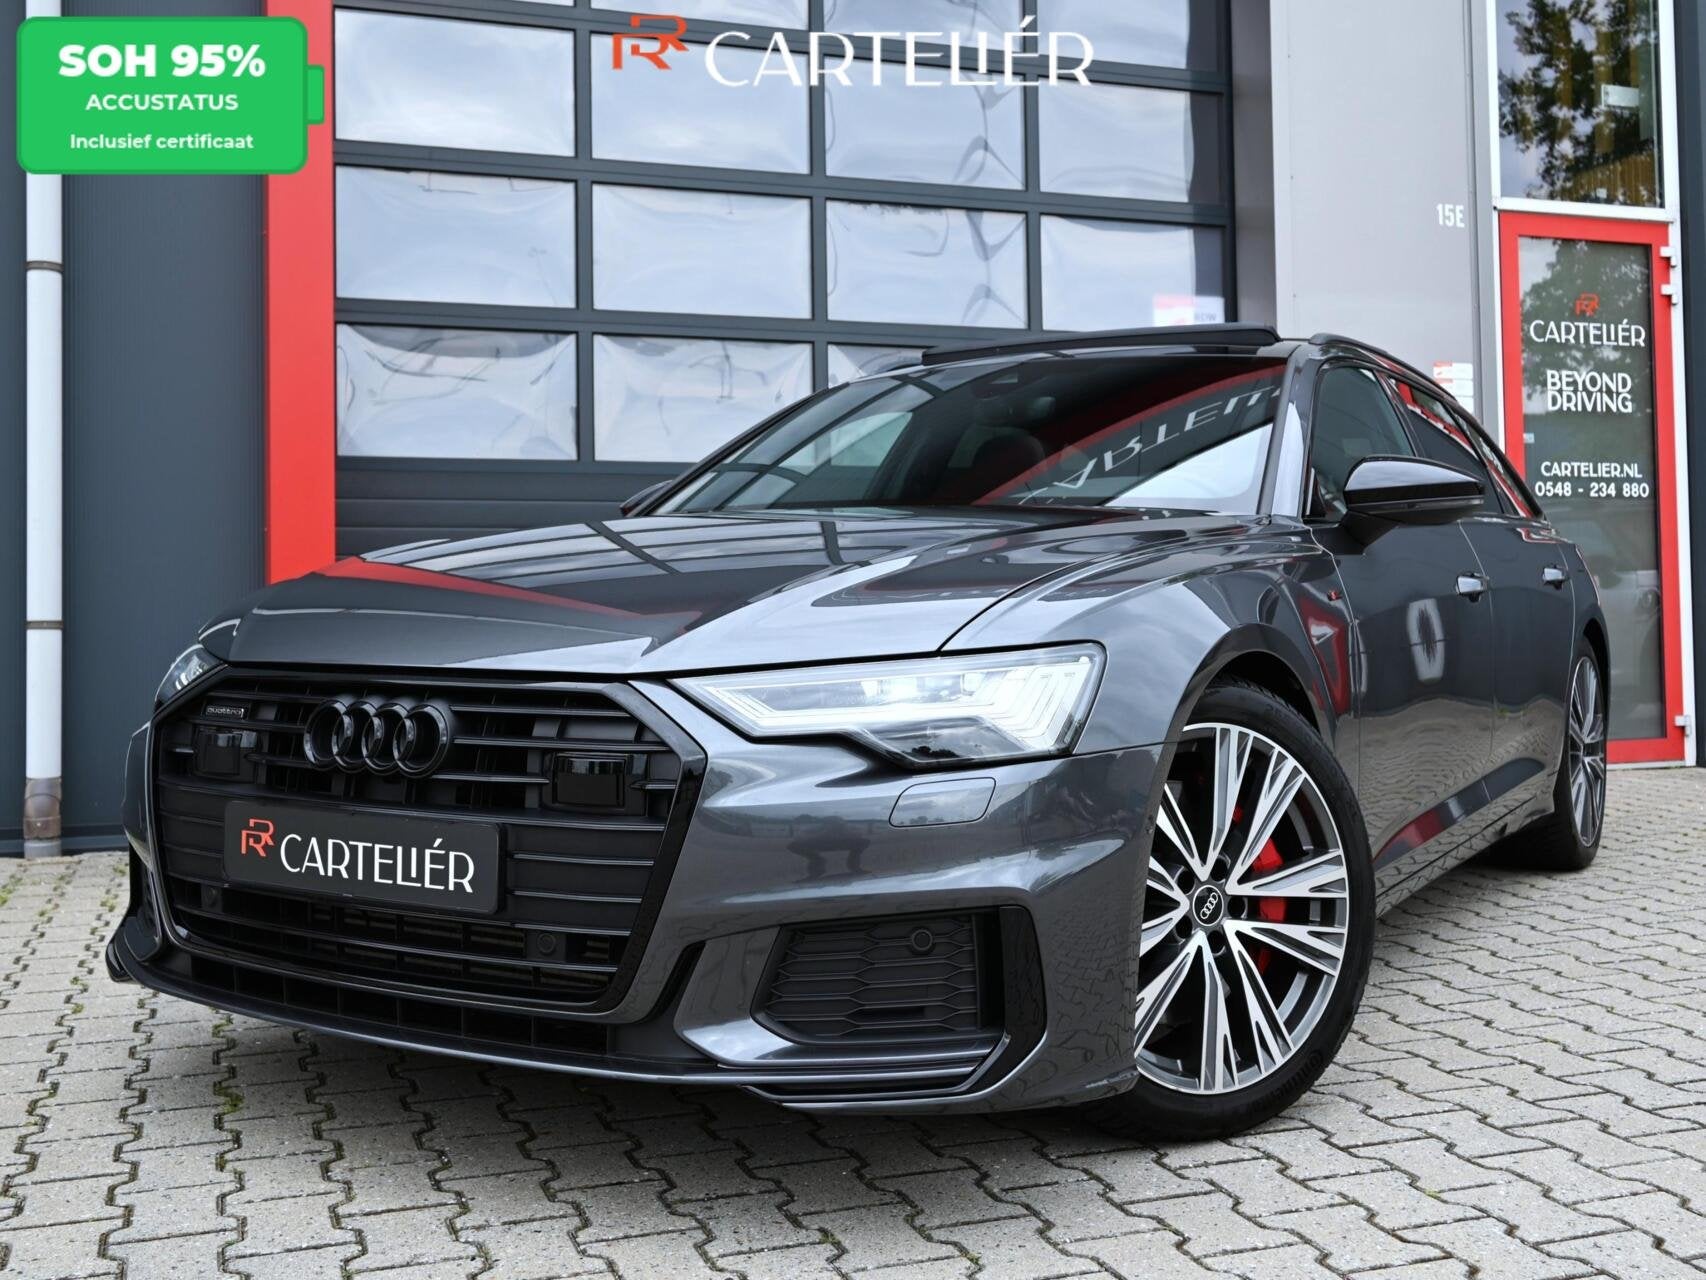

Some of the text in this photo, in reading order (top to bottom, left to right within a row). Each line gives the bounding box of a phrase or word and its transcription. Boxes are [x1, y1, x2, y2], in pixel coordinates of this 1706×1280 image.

[1436, 203, 1465, 228] 15E
[1546, 370, 1632, 393] BEYOND
[1547, 391, 1633, 413] DRIVING
[1540, 461, 1643, 479] CARTELIER.NL
[1534, 482, 1572, 497] 0548
[1589, 482, 1616, 498] 234
[1622, 483, 1650, 498] 880
